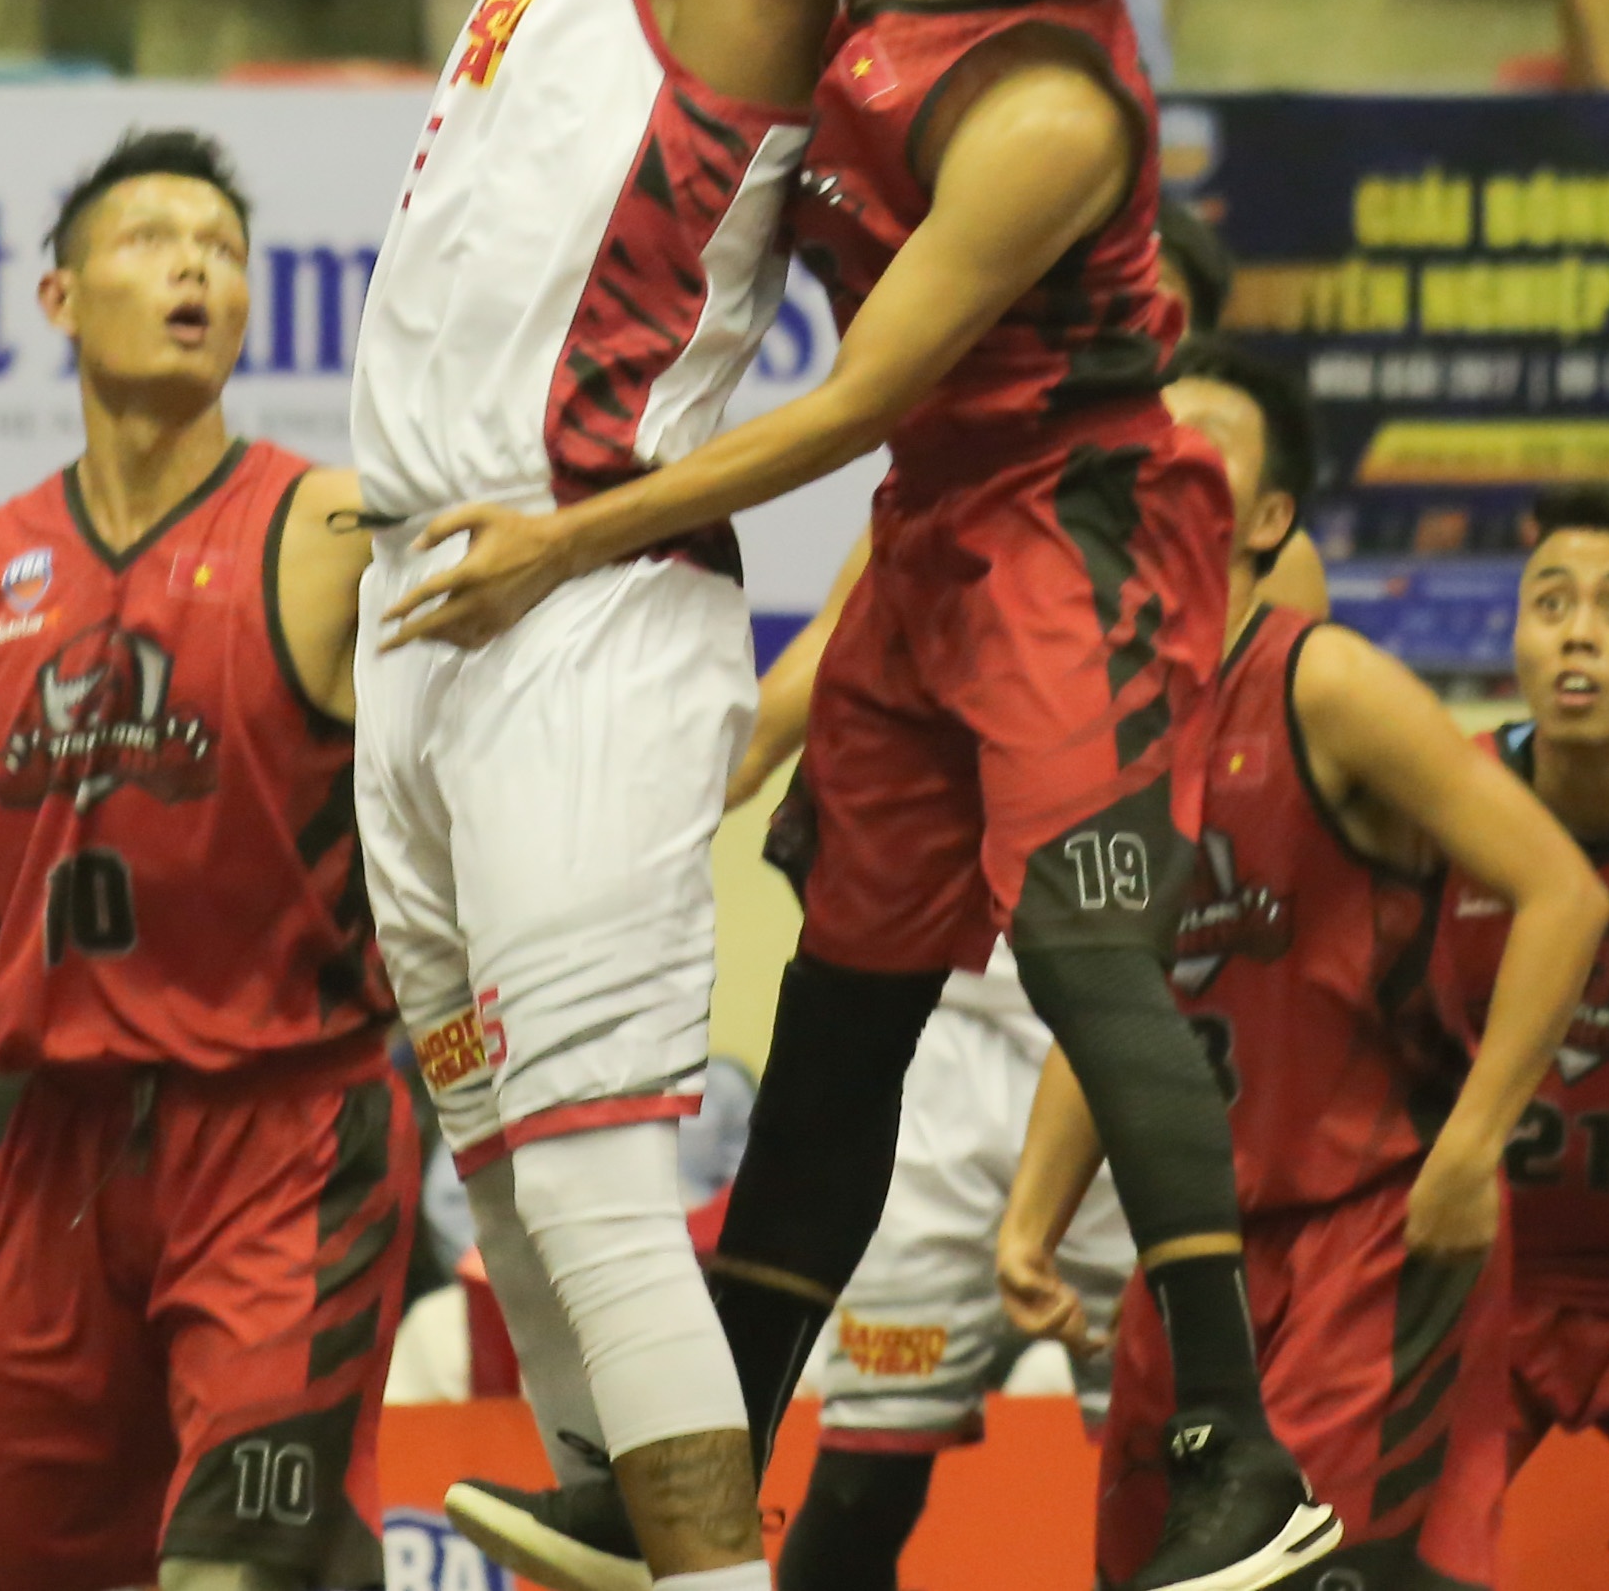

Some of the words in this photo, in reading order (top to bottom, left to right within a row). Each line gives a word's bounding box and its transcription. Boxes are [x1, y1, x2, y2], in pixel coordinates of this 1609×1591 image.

[44, 847, 139, 970] 10
[1065, 831, 1150, 910] 19
[233, 1440, 315, 1524] 10
[383, 1526, 491, 1591] BA
